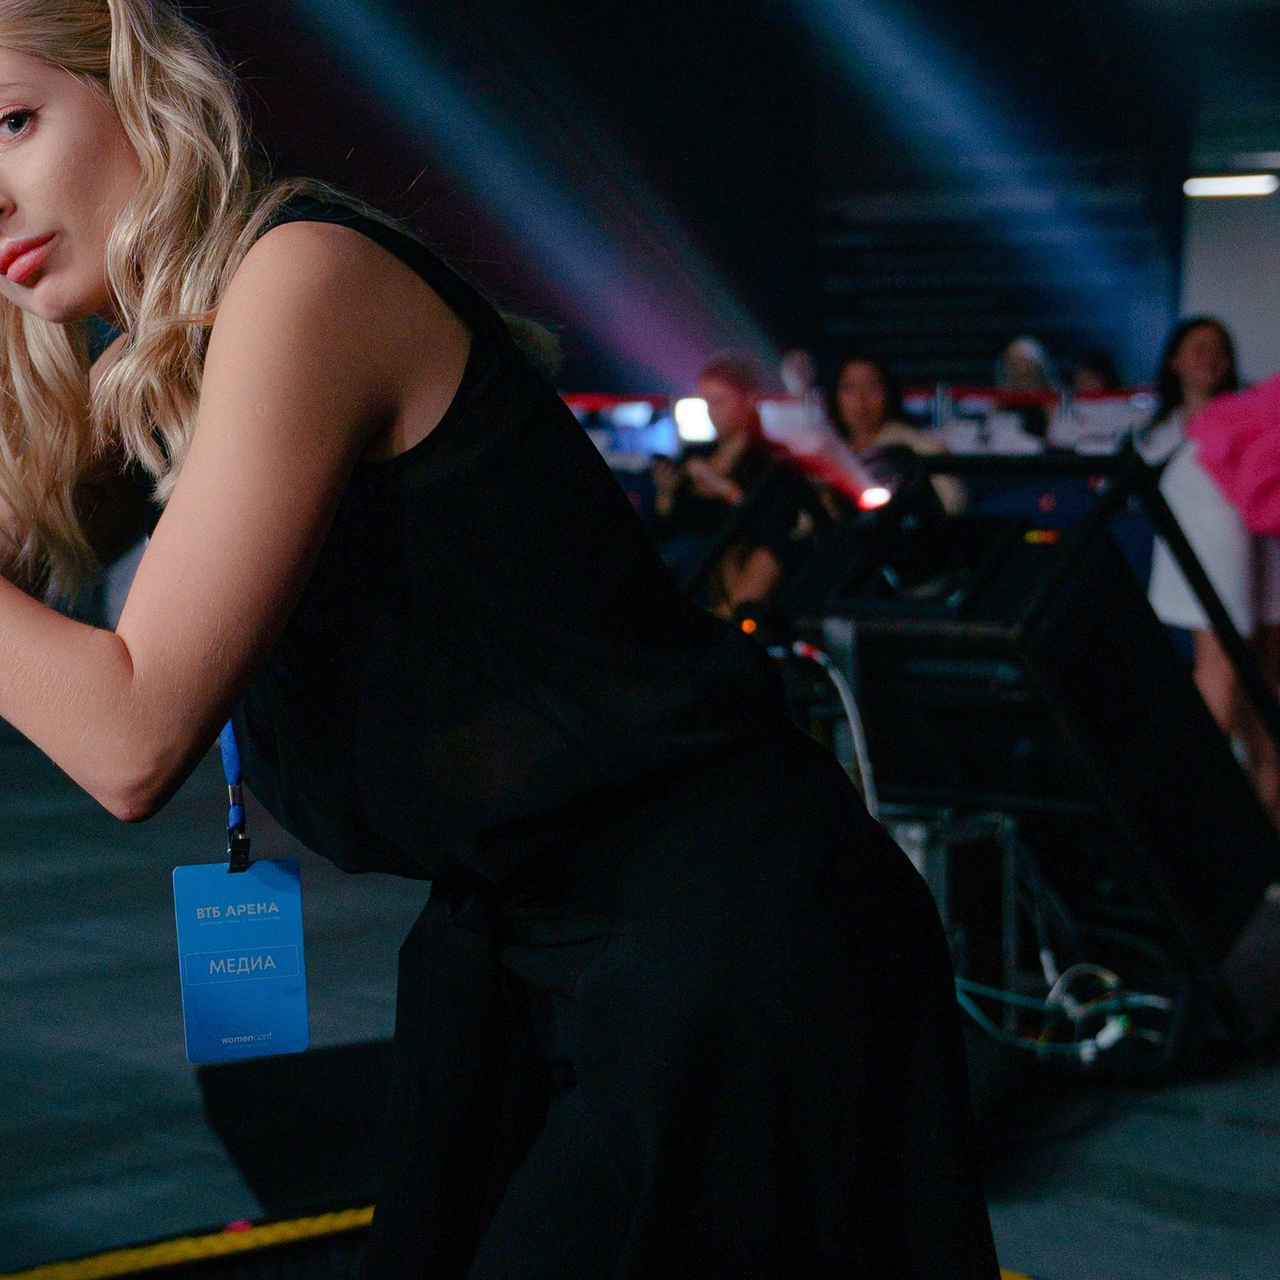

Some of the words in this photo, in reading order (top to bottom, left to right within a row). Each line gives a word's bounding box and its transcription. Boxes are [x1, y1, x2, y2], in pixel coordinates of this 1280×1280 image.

[196, 906, 221, 919] ВТБ
[225, 902, 280, 917] АРЕНА
[209, 955, 276, 975] МЕДИА
[221, 1031, 273, 1045] womenconf
